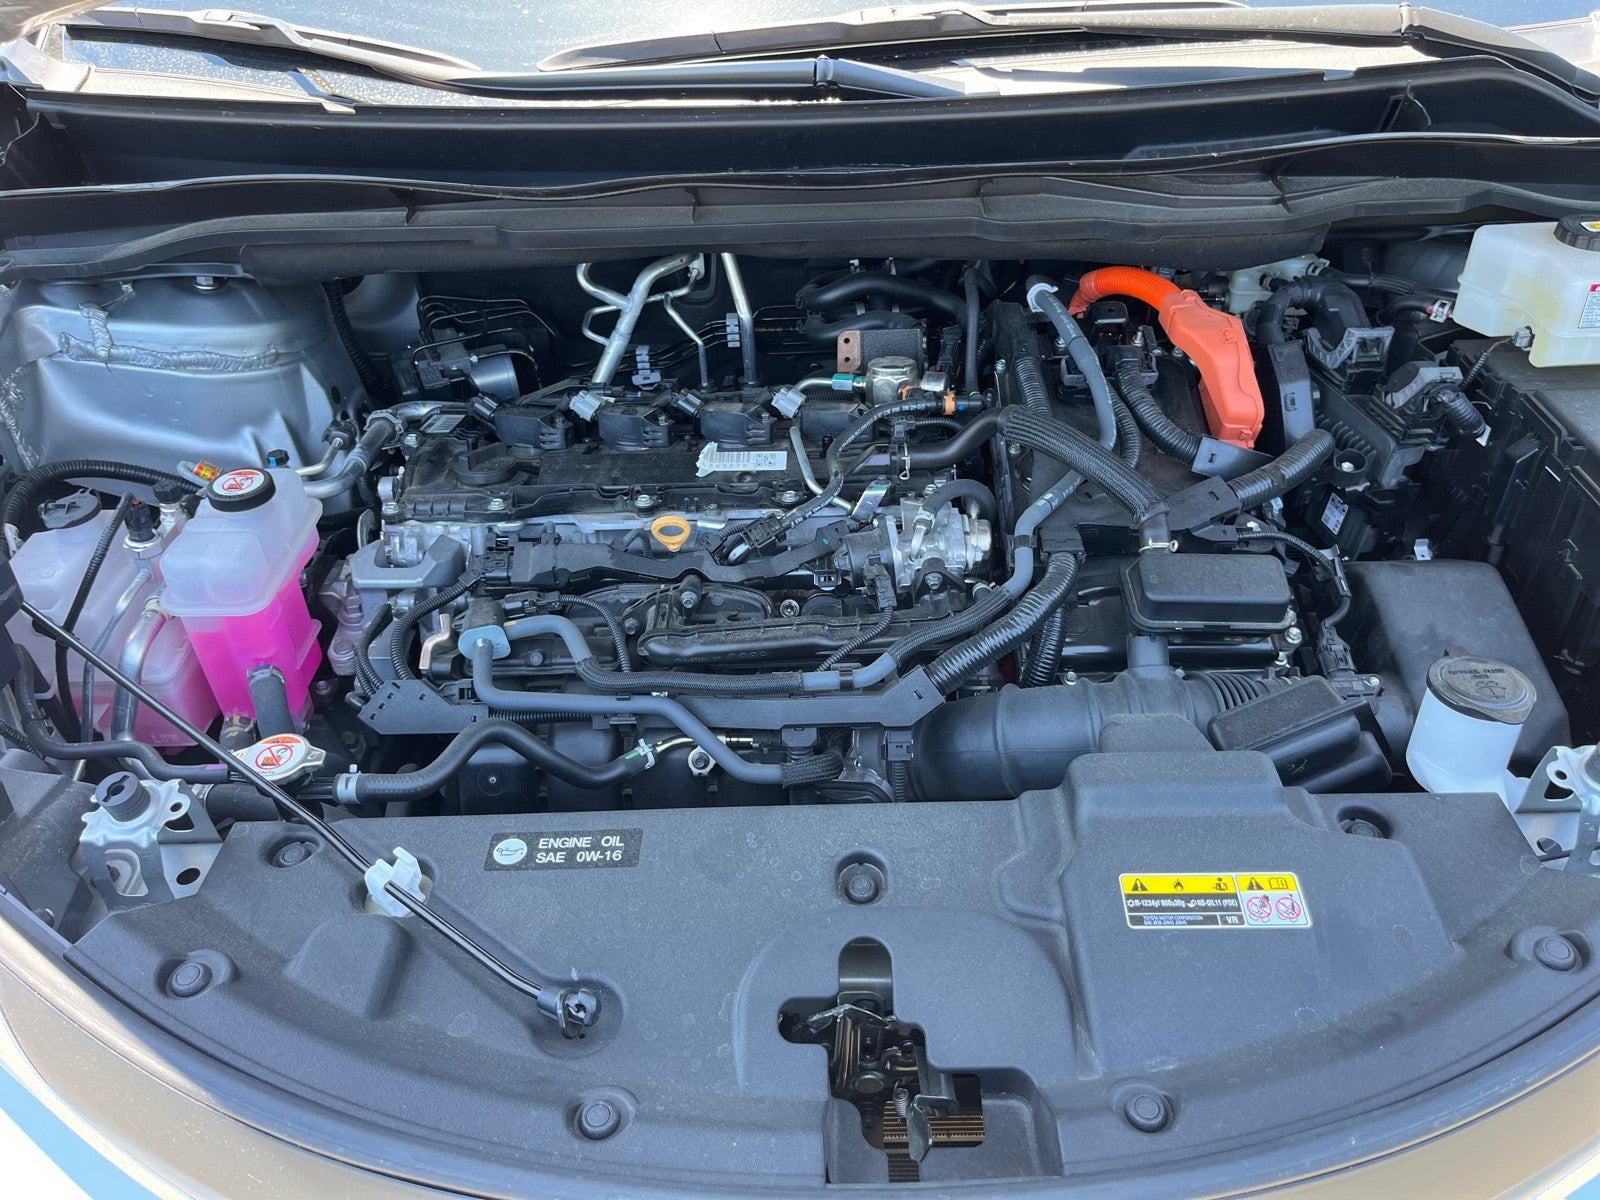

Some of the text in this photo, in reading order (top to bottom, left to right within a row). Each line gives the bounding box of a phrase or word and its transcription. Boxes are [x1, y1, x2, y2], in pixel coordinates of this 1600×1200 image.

[538, 835, 625, 849] ENGINE OIL
[535, 849, 623, 864] SAE 0W-16
[1225, 915, 1240, 924] VR
